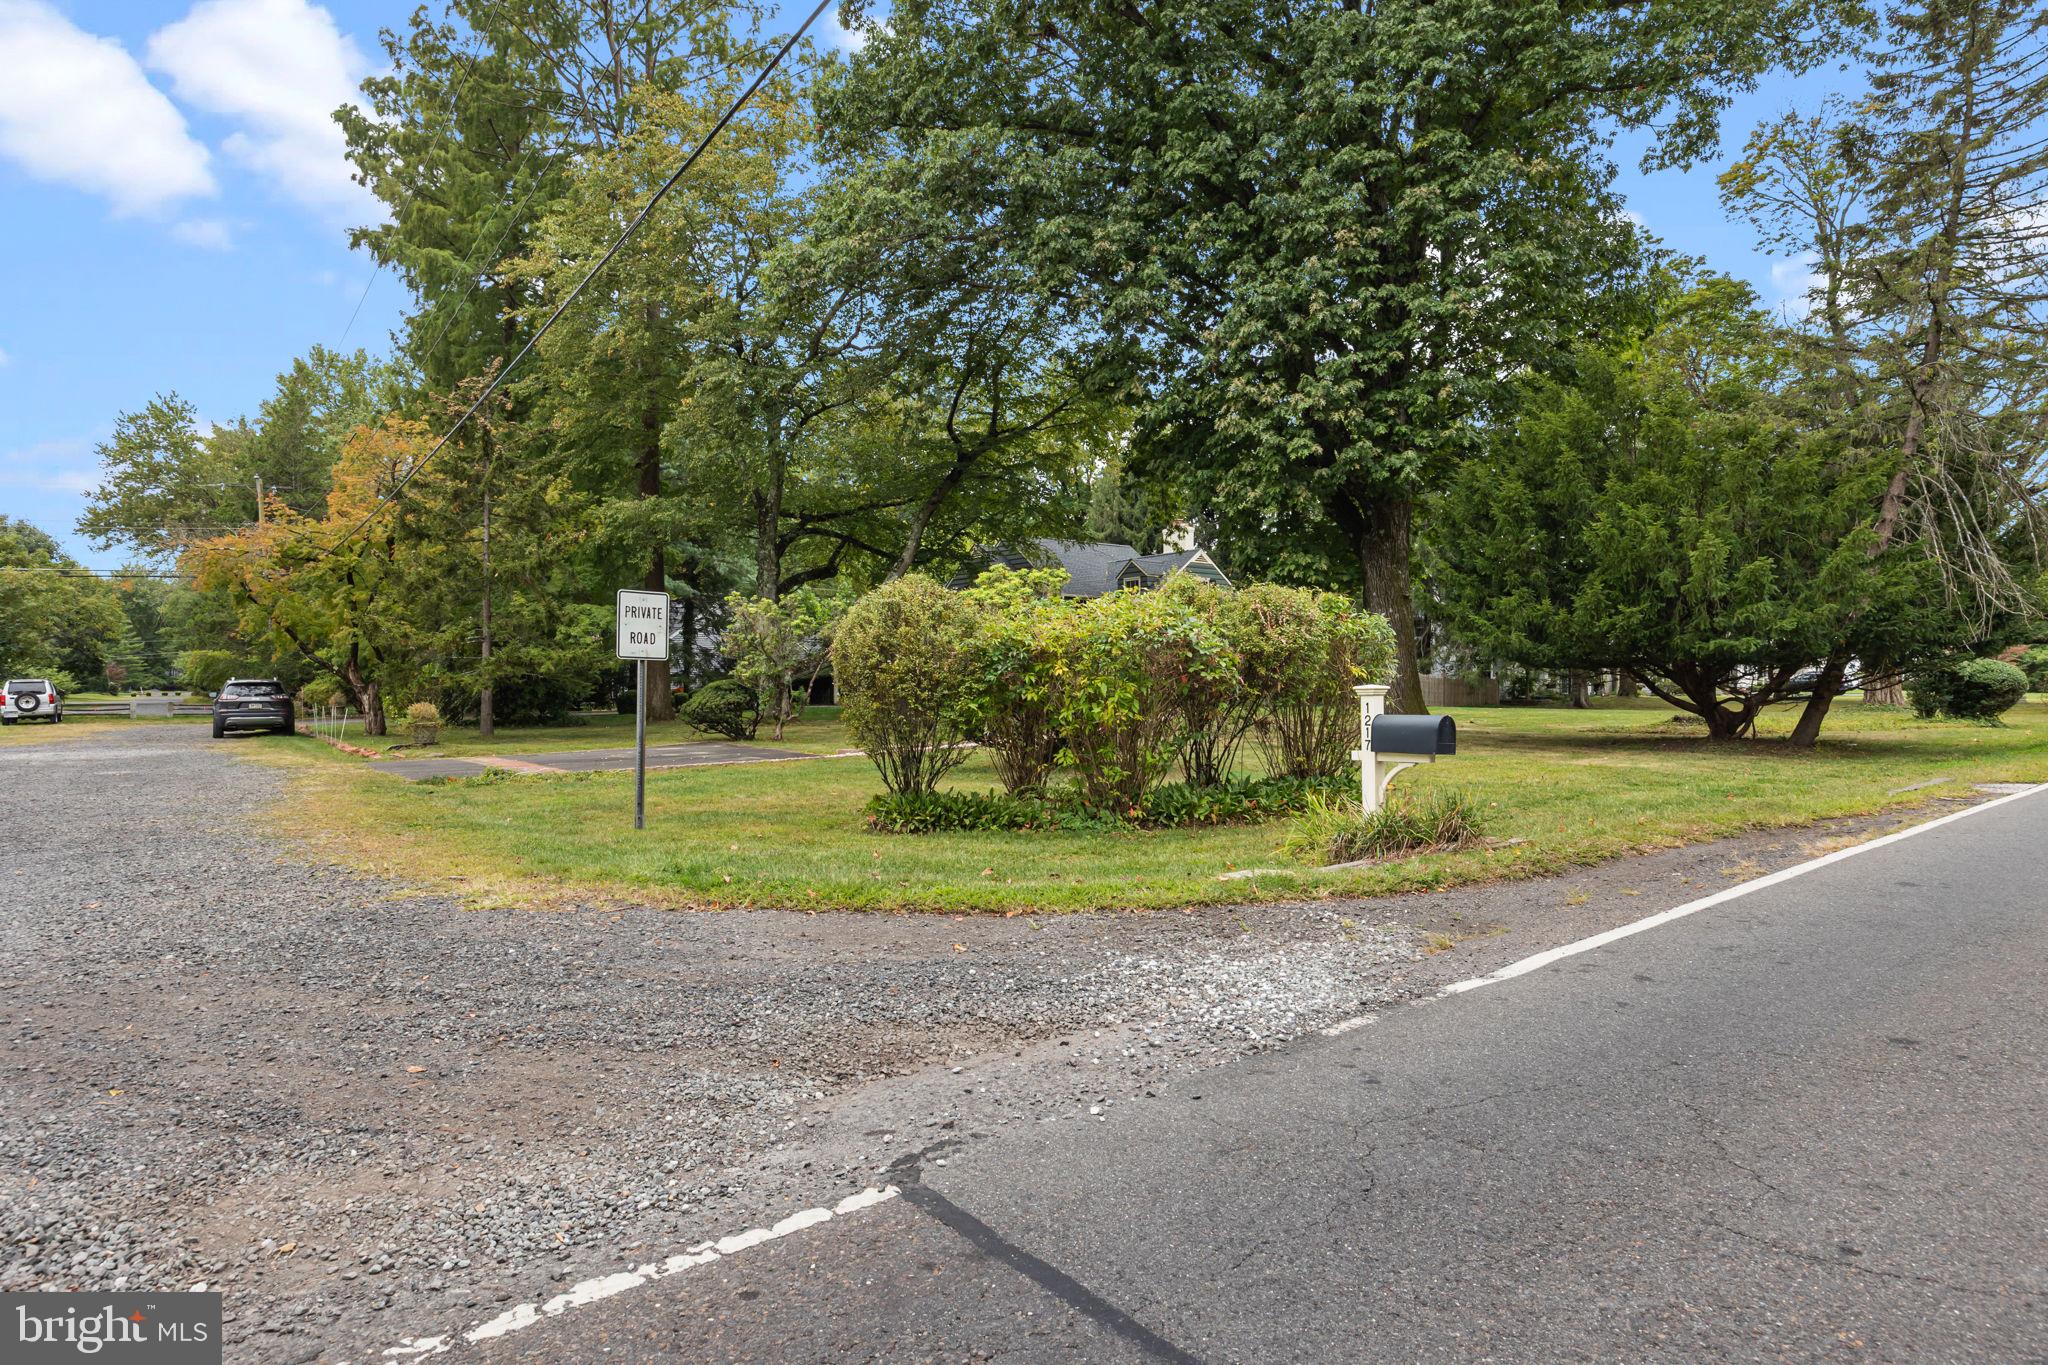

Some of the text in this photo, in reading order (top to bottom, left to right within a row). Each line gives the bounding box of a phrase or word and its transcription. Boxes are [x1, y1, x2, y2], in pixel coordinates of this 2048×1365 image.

[625, 605, 663, 620] PRIVATE
[630, 631, 656, 645] ROAD
[1364, 702, 1372, 751] 1217
